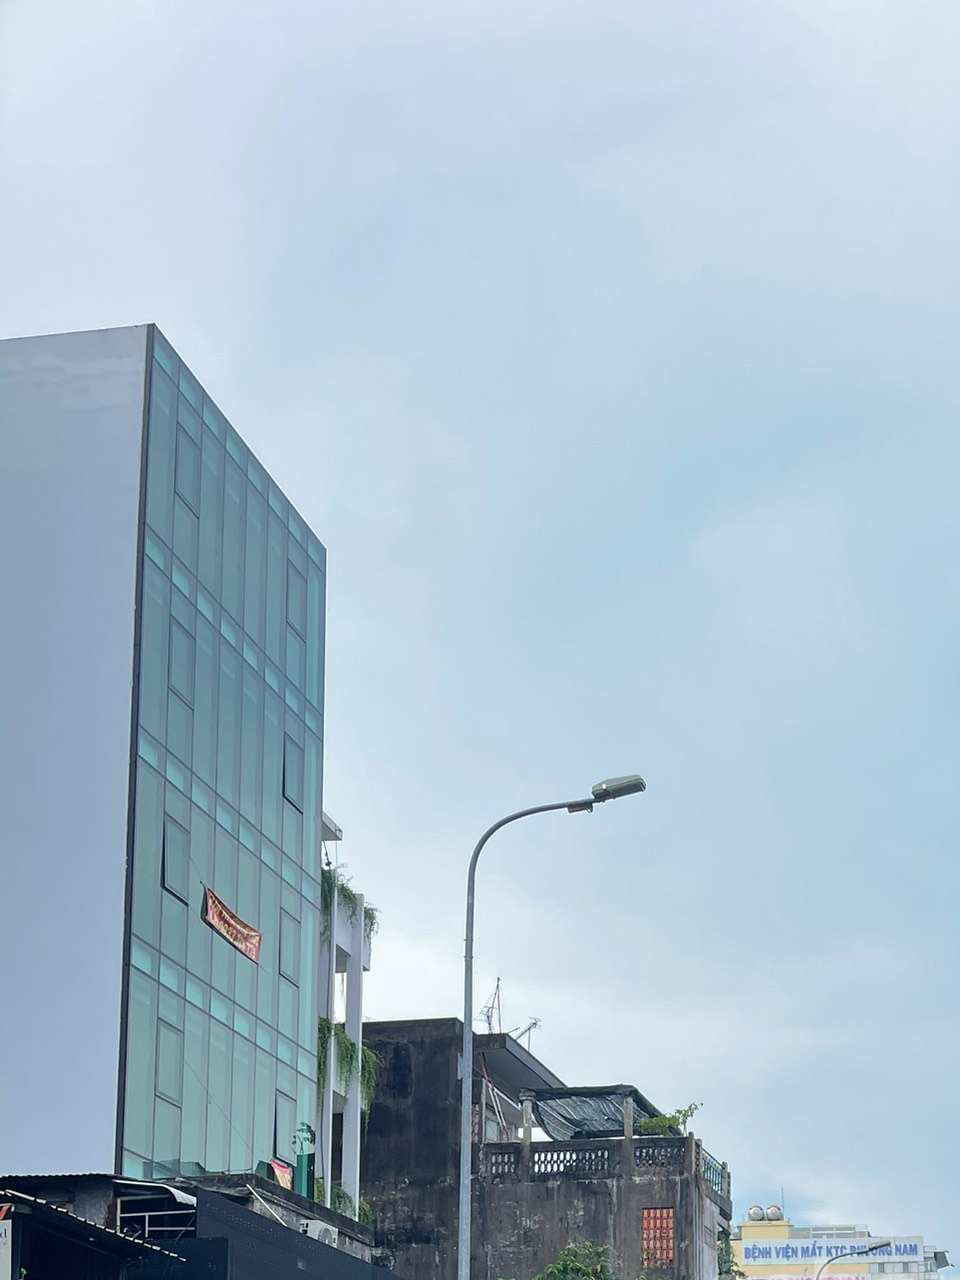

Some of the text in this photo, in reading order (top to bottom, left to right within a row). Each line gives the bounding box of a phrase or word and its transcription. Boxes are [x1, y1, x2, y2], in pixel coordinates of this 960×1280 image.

[744, 1244, 772, 1261] BỆNH
[775, 1243, 798, 1260] VIỆN
[826, 1245, 847, 1258] KTC
[895, 1243, 918, 1256] NAM
